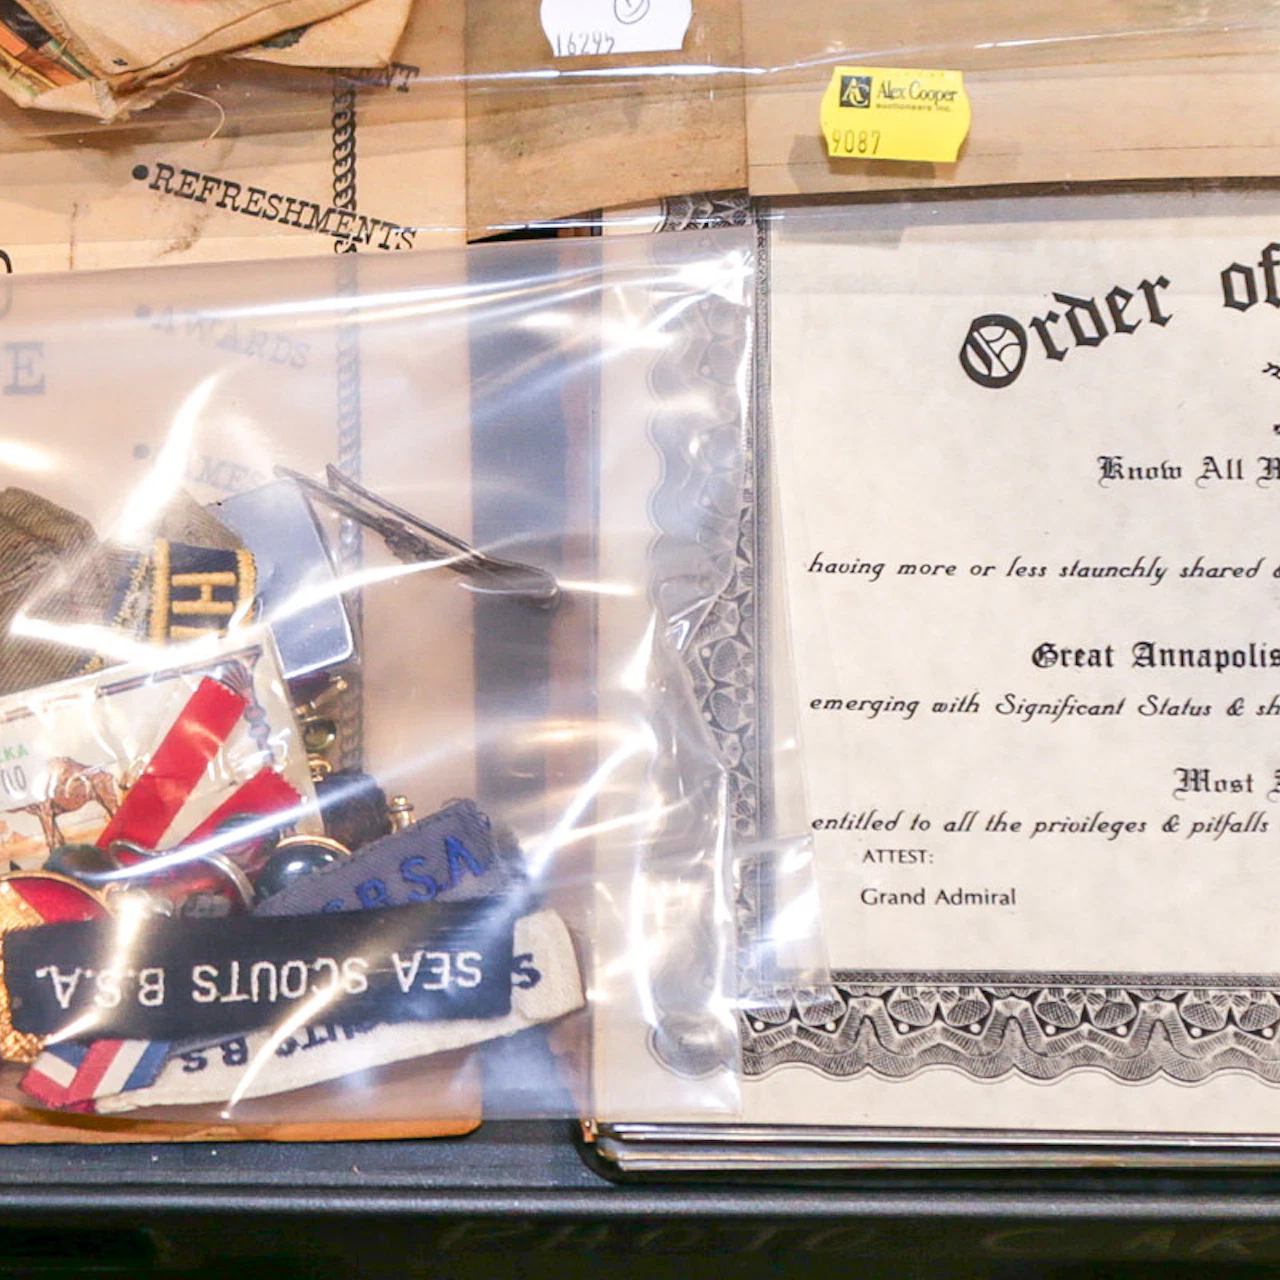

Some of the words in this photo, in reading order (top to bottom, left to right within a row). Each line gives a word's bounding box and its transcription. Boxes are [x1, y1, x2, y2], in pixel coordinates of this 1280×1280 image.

[877, 83, 906, 101] Alex
[908, 84, 959, 106] Cooper
[832, 129, 881, 155] 9087
[148, 162, 417, 250] REFRESHMENTS
[960, 275, 1173, 389] Order
[1097, 455, 1181, 489] Know
[1196, 455, 1243, 489] All
[807, 552, 885, 582] having
[897, 563, 957, 577] more
[970, 564, 996, 577] or
[1006, 554, 1047, 578] less
[1059, 554, 1167, 586] staunchly
[1179, 556, 1265, 579] shared
[1031, 641, 1114, 669] Great
[810, 695, 920, 721] emerging
[932, 691, 980, 714] with
[995, 692, 1126, 724] Significant
[1138, 693, 1211, 717] Status
[1226, 696, 1244, 717] &
[1173, 766, 1253, 801] Most
[811, 808, 904, 832] entitled
[910, 813, 932, 832] to
[944, 810, 980, 833] all
[985, 810, 1022, 833] the
[1029, 810, 1147, 842] privileges
[1162, 813, 1180, 833] &
[1187, 810, 1269, 842] pitfalls
[862, 848, 934, 865] ATTEST:
[860, 887, 926, 906] Grand
[934, 887, 1016, 906] Admiral
[191, 956, 369, 1006] SCOUTS
[391, 951, 483, 991] SEA
